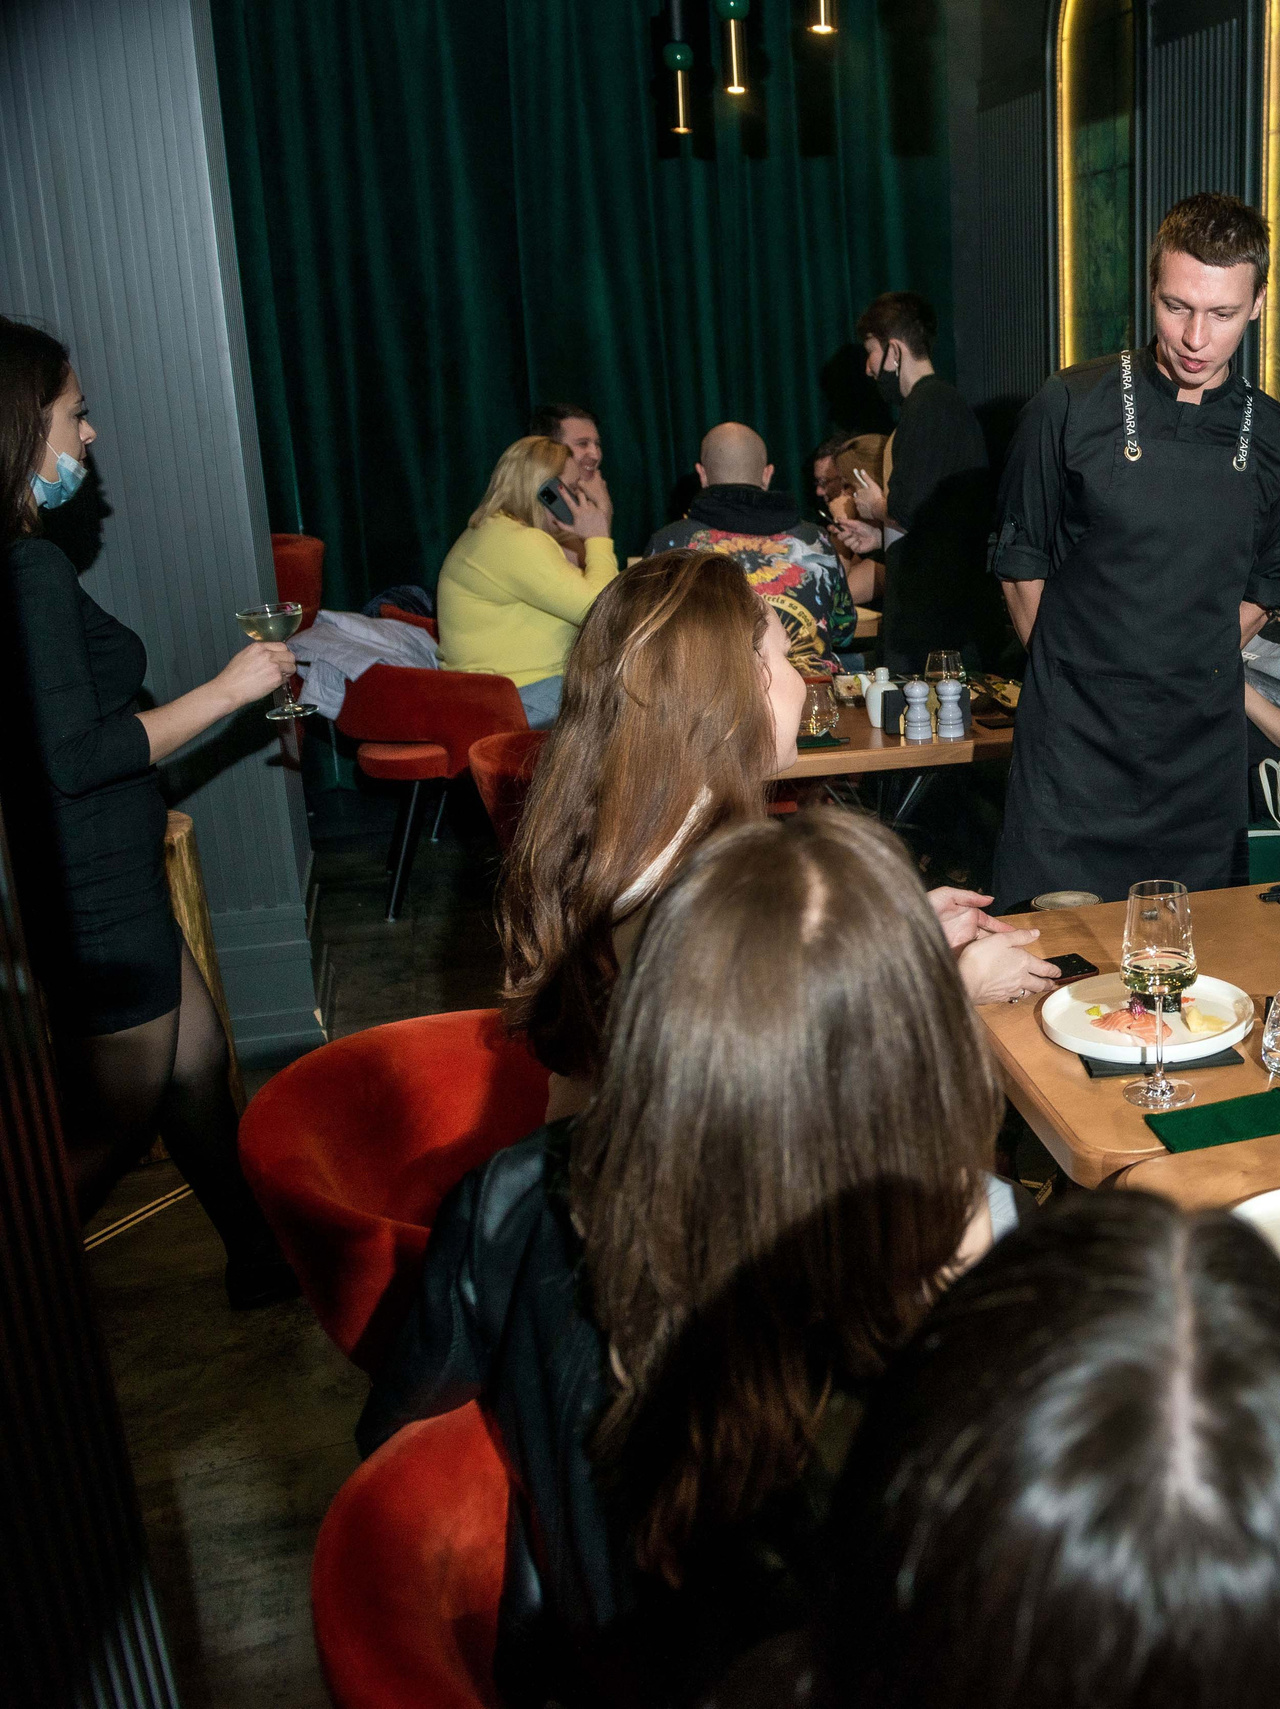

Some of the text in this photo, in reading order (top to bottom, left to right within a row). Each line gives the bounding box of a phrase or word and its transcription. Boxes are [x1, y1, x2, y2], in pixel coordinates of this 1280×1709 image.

[1121, 354, 1133, 390] ZAPARA
[1123, 393, 1136, 436] ZAPARA
[1237, 436, 1249, 462] ZAPA
[788, 602, 798, 611] so
[797, 610, 813, 627] good
